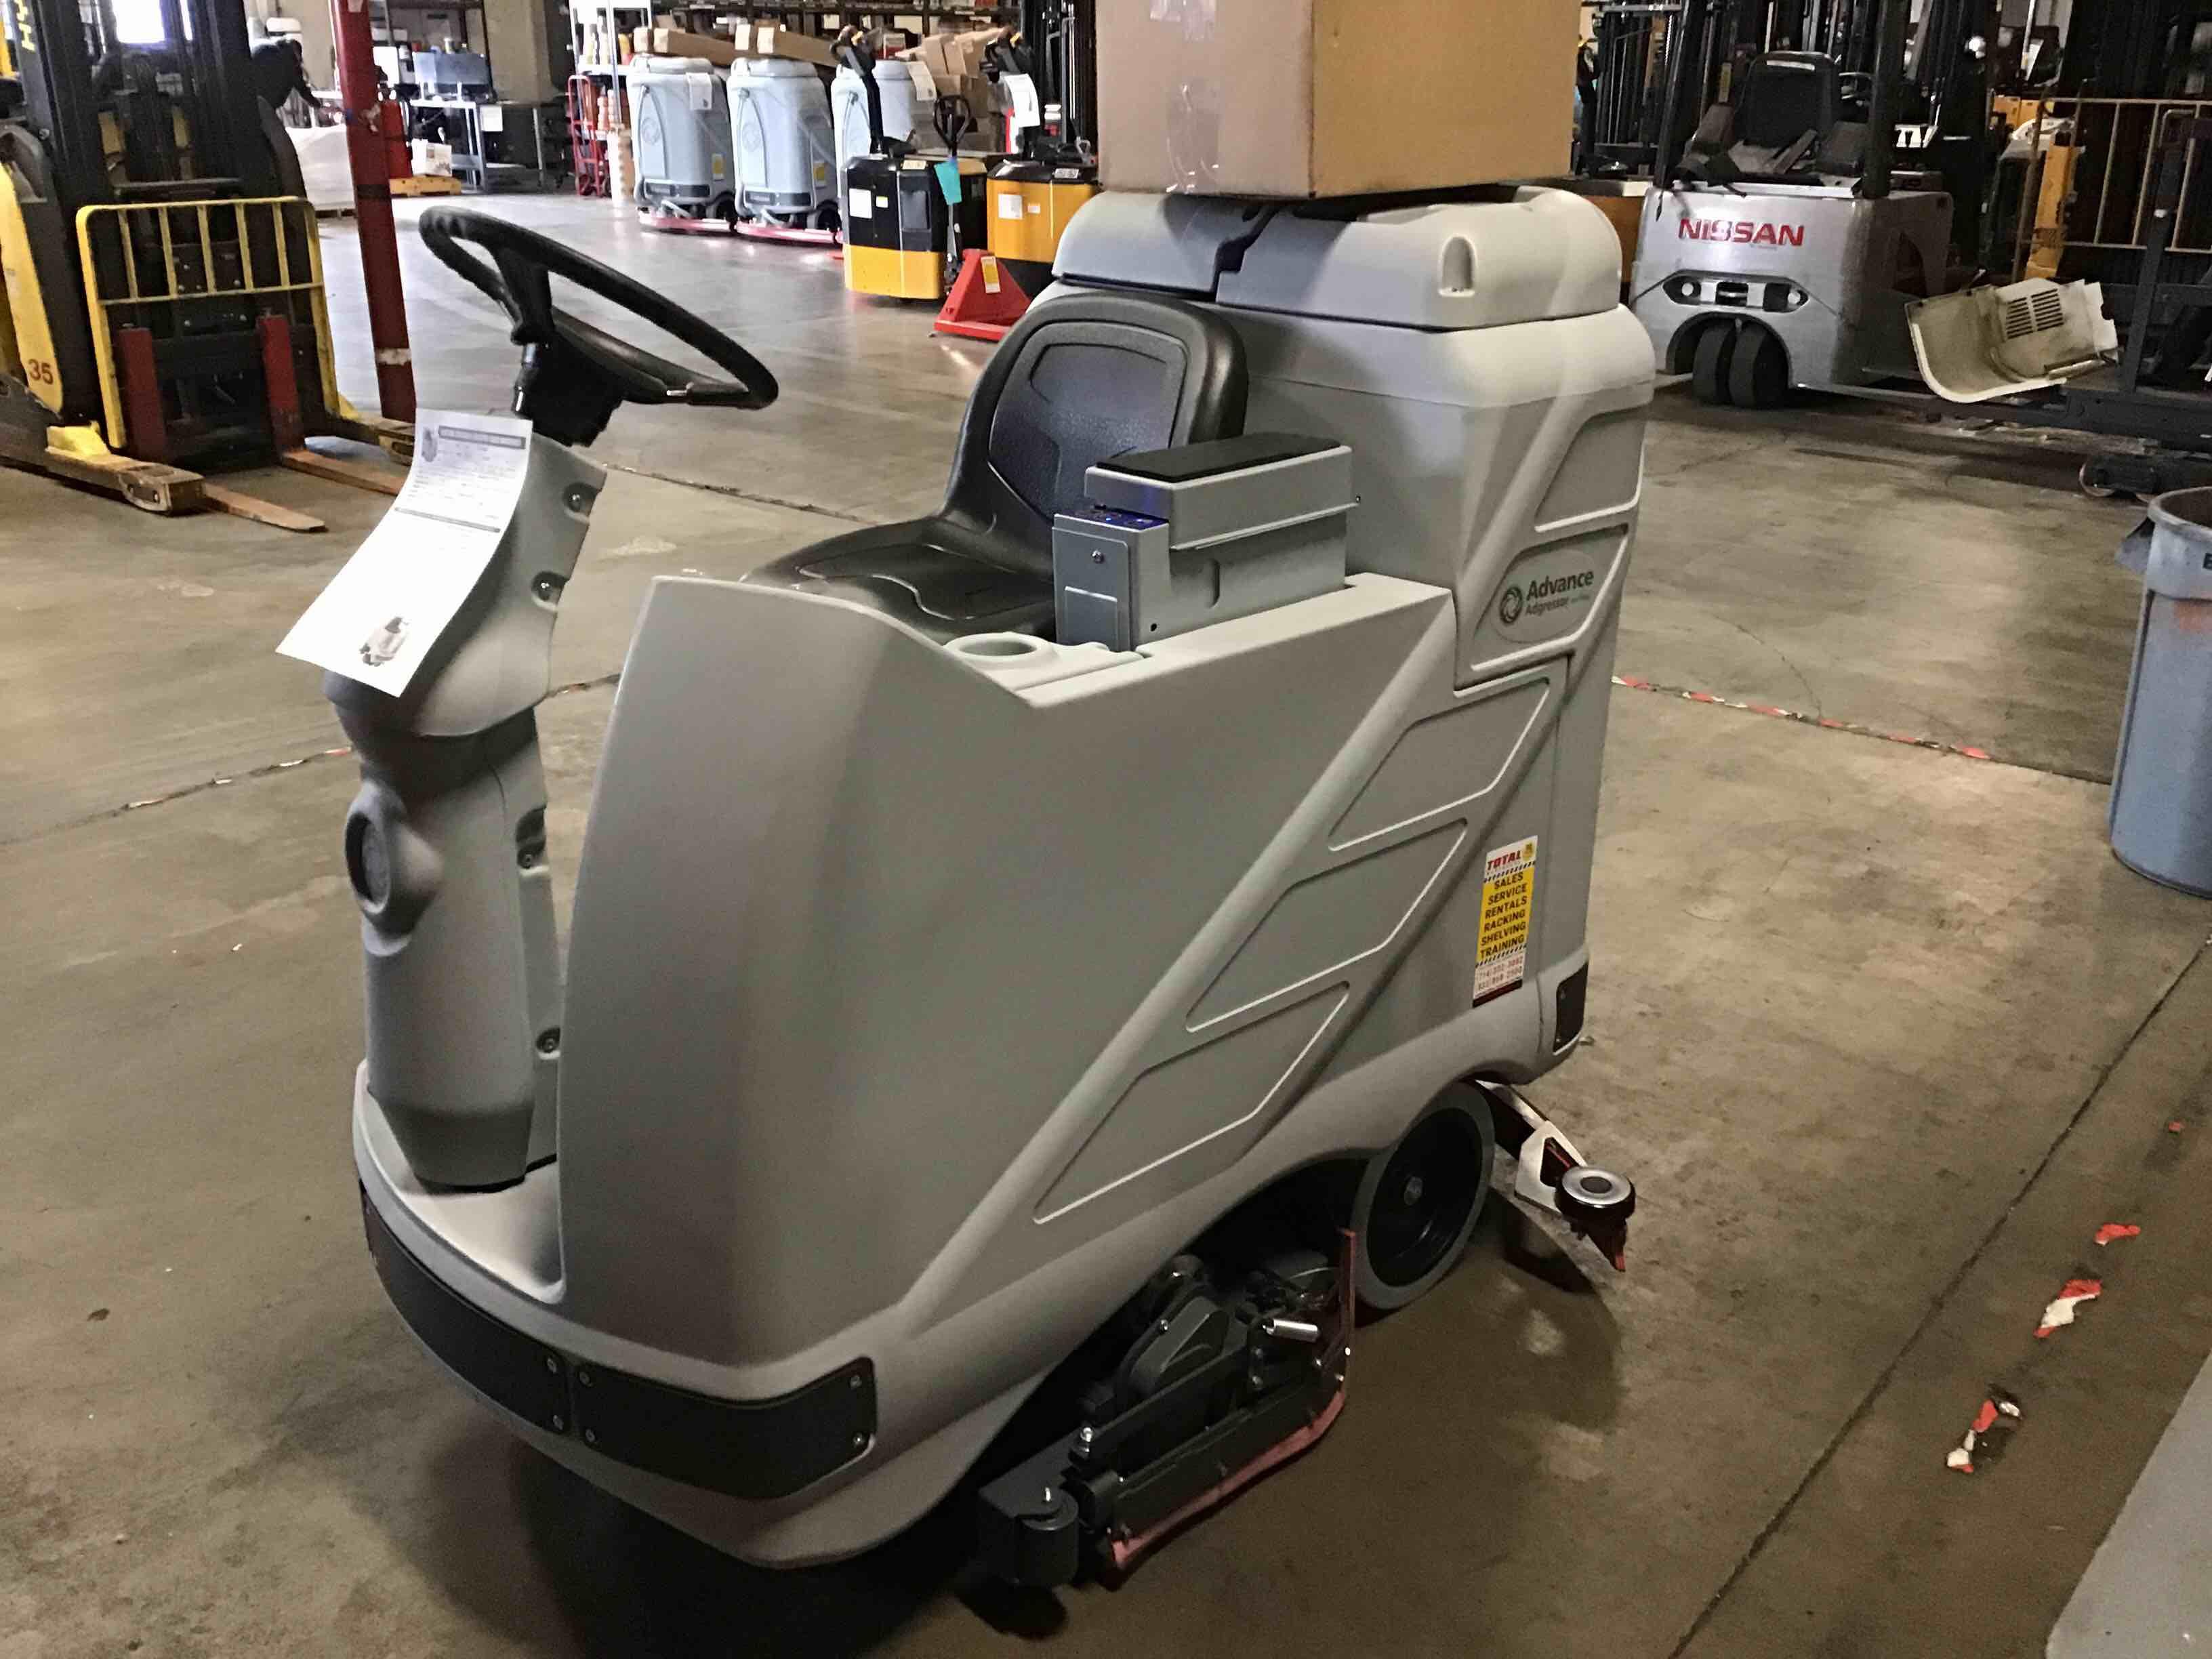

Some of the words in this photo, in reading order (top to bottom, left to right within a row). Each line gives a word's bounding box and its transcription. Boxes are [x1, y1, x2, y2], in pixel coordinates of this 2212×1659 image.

[1678, 218, 1805, 246] NISSAN
[28, 359, 54, 385] 35
[1526, 571, 1594, 600] Advance
[1487, 851, 1521, 870] TOTAL
[1494, 872, 1523, 890] SALES
[1488, 884, 1528, 905] SERVICE
[1485, 895, 1528, 919] RENTALS
[1483, 909, 1525, 933] RACKING
[1481, 922, 1526, 946] SHELVING
[1479, 935, 1524, 960] TRAINING
